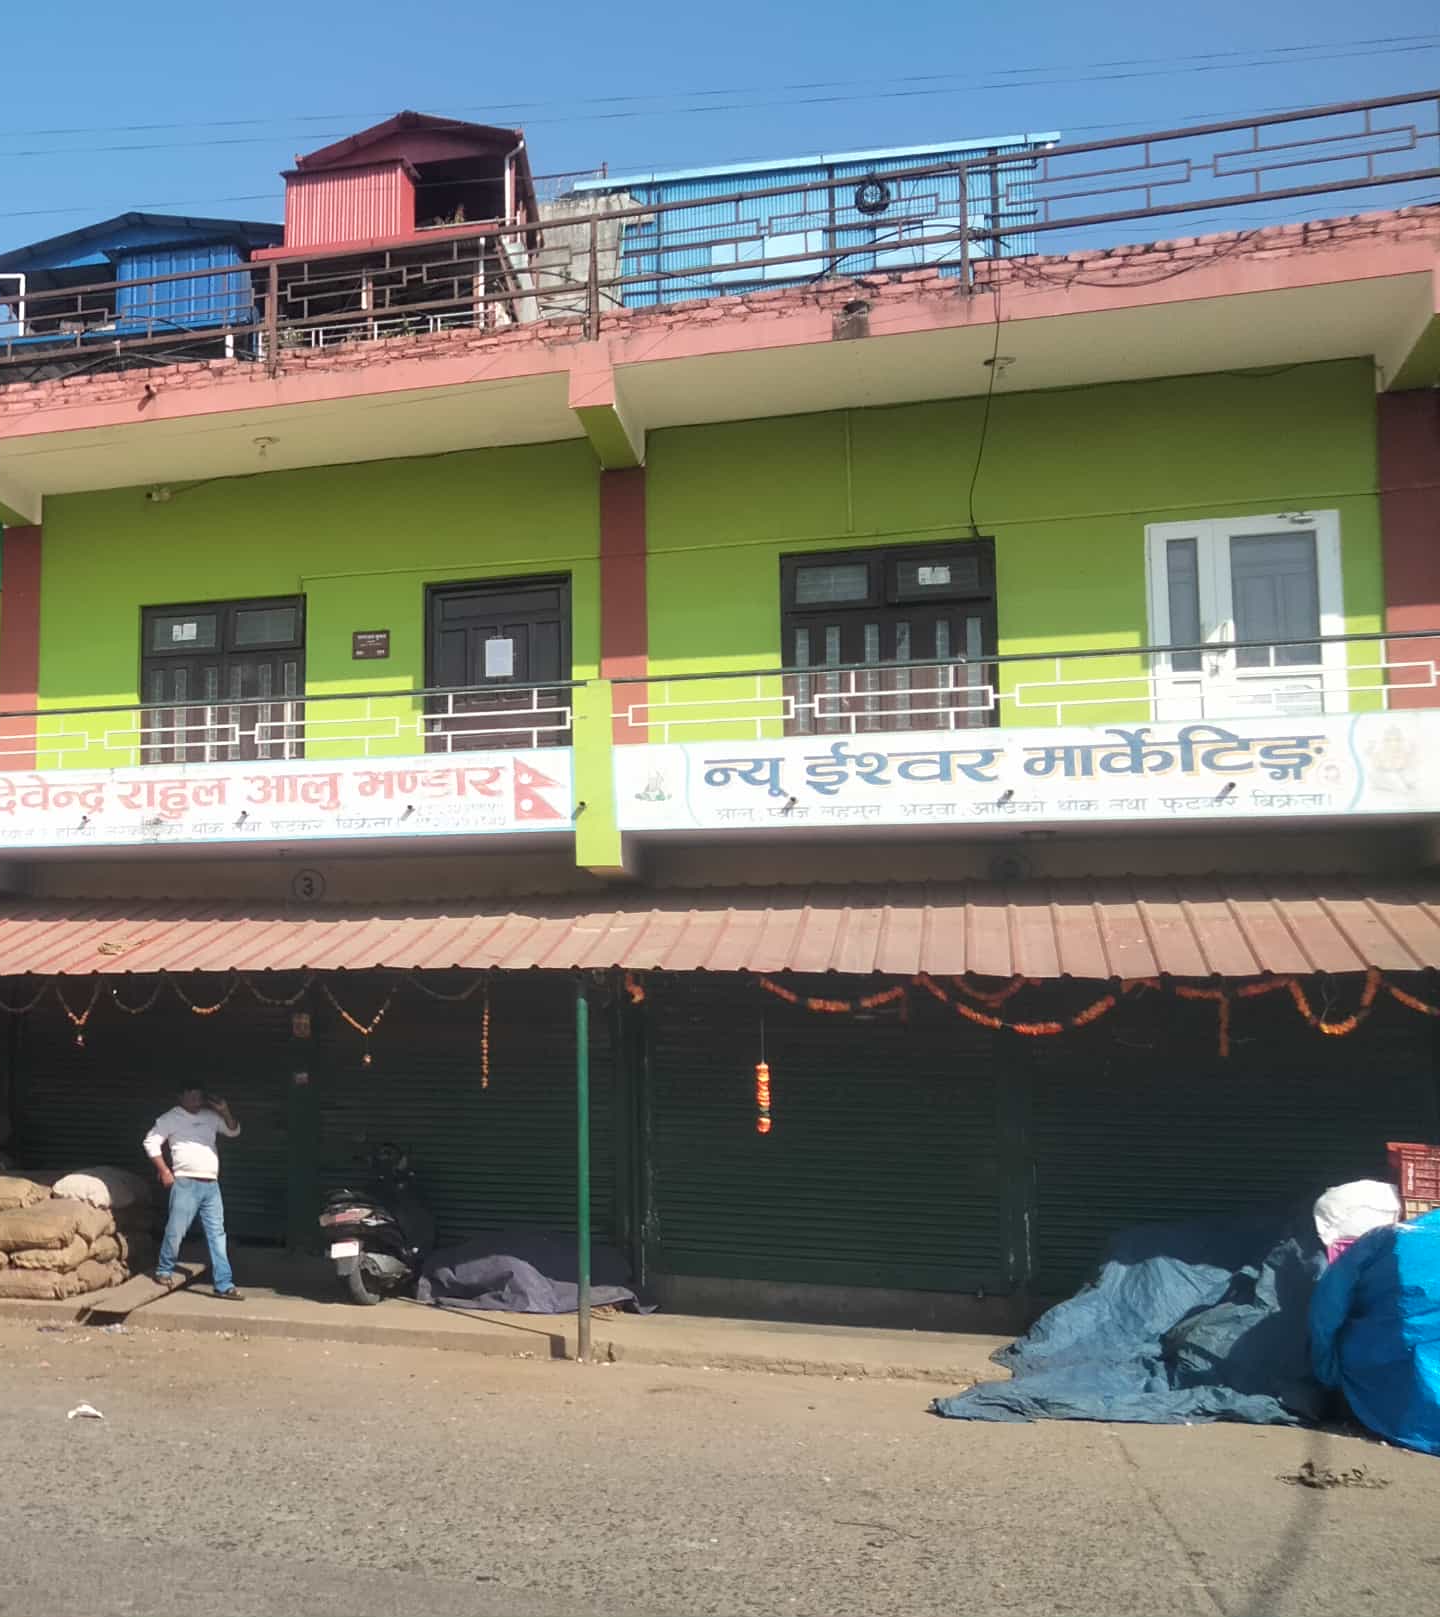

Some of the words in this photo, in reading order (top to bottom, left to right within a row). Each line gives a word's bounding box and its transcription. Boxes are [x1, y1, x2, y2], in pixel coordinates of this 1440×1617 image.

[116, 776, 231, 820] राहुल
[246, 772, 342, 811] आलु
[353, 764, 508, 800] भण्डार
[703, 757, 790, 798] न्यू
[804, 743, 1006, 796] ईश्वर
